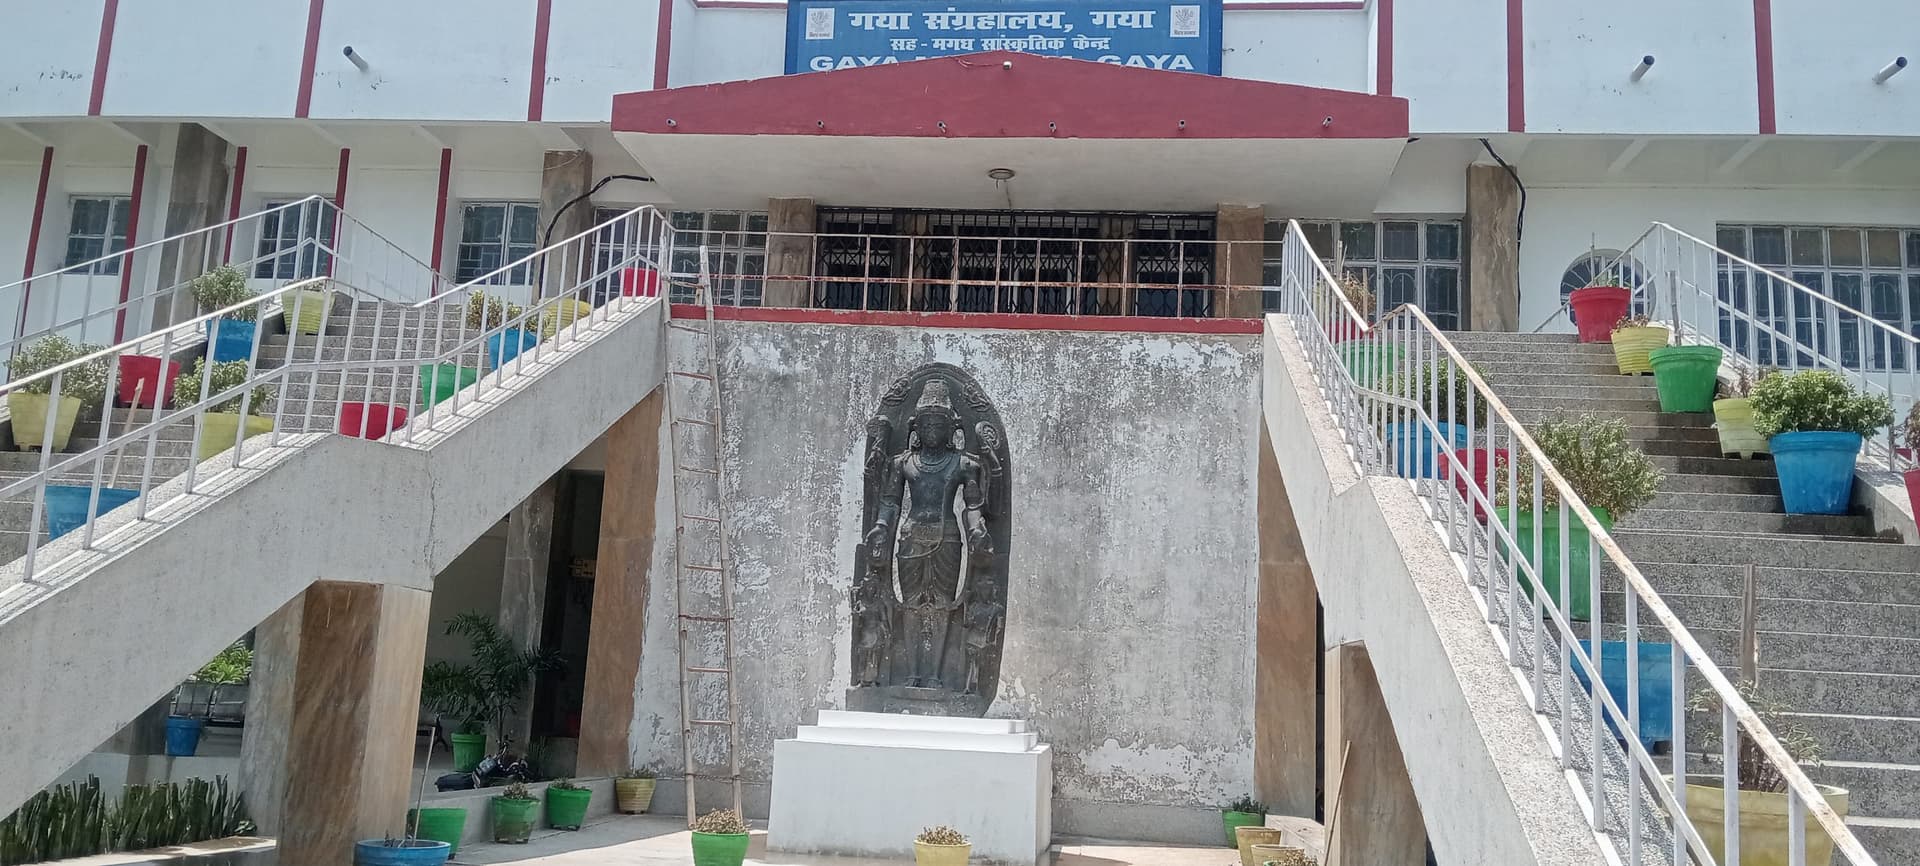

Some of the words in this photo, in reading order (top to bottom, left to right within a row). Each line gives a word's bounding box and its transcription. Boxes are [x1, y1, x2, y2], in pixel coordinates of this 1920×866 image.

[848, 12, 912, 30] गया
[922, 7, 1073, 32] संग्रहालय,
[1089, 11, 1156, 29] गया
[889, 38, 918, 51] सह
[931, 38, 975, 51] मगध
[1071, 34, 1111, 50] केन्द्र
[1097, 54, 1194, 70] GAYA
